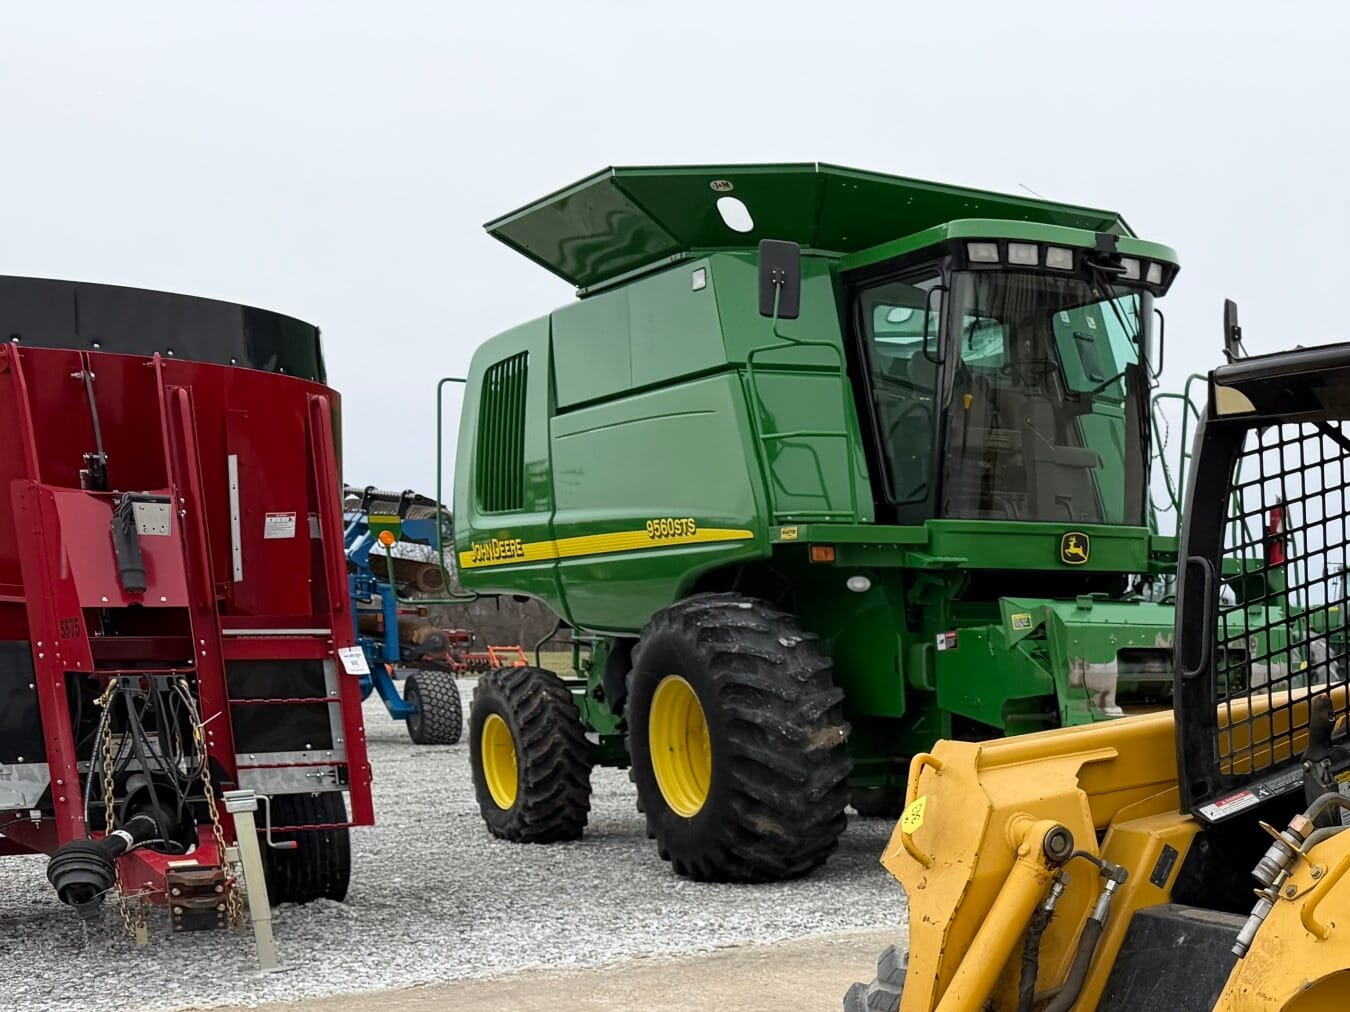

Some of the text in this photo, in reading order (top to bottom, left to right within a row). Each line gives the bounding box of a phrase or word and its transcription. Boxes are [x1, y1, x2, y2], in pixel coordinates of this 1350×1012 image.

[646, 517, 697, 539] 9560STS
[471, 538, 525, 563] JOHN DEERE
